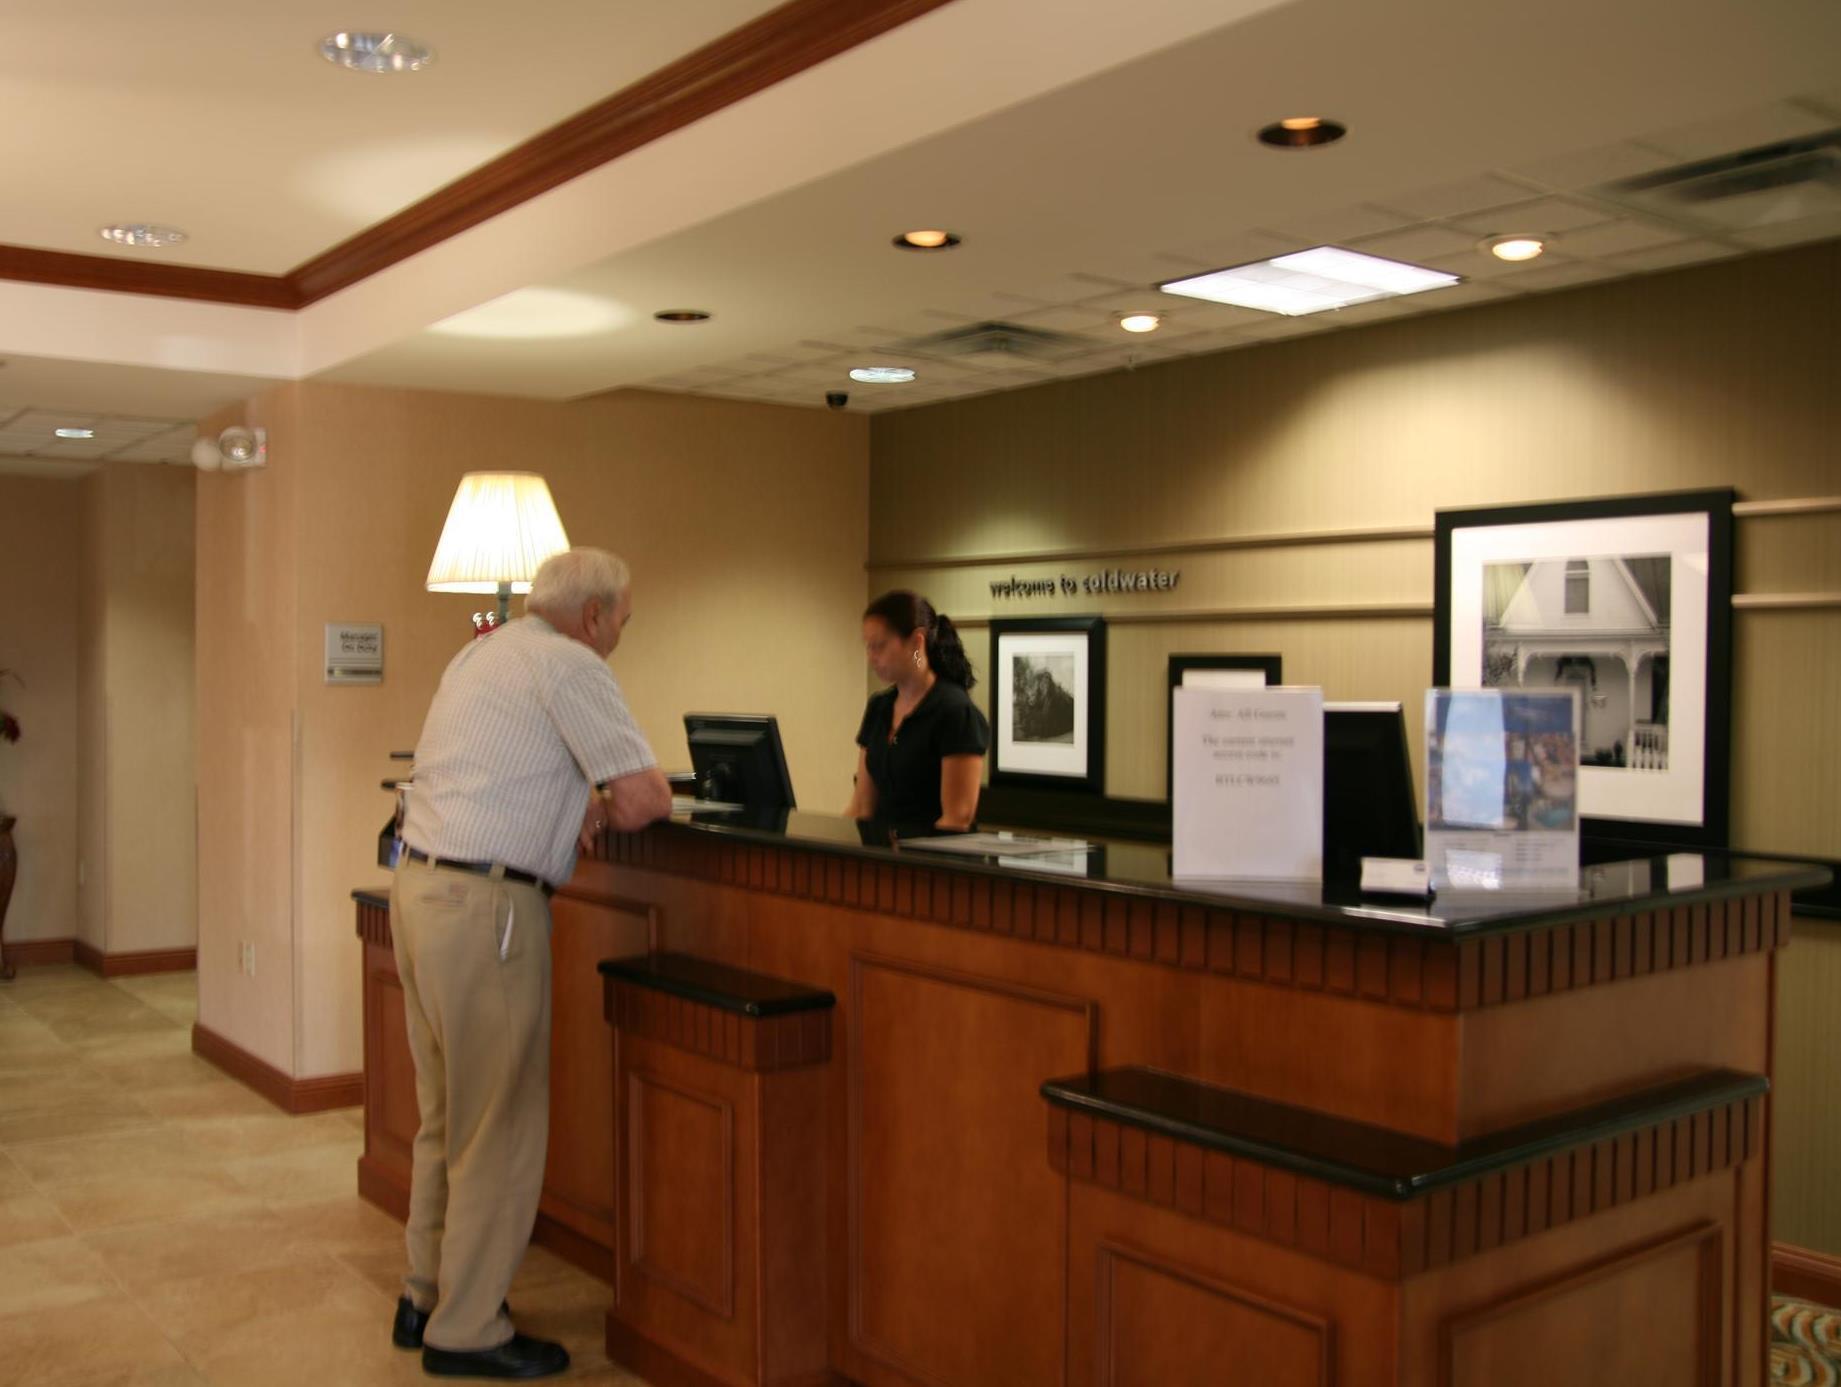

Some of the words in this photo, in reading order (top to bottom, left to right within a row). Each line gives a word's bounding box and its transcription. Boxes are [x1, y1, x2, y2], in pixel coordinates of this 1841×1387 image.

[990, 575, 1056, 599] welcome
[1059, 575, 1078, 595] to
[1082, 568, 1180, 594] coldwater
